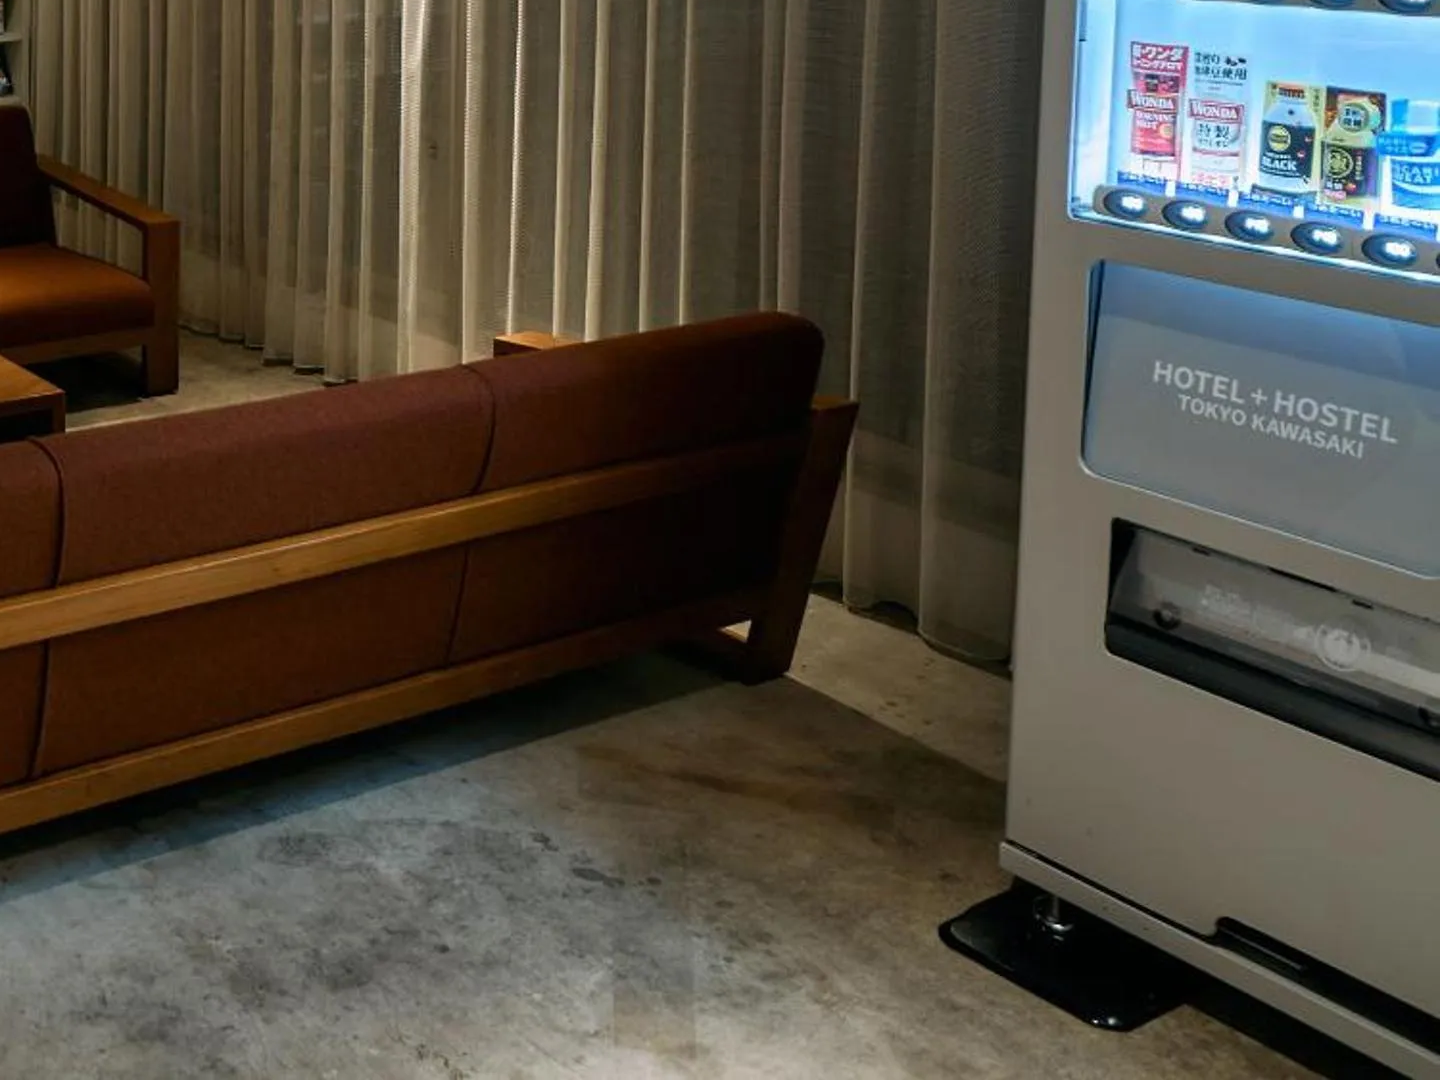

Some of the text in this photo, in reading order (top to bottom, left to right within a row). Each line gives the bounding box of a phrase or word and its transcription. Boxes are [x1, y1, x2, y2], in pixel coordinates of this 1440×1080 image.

[1191, 101, 1238, 119] WONDA
[1152, 360, 1245, 405] HOTEL
[1273, 390, 1399, 445] HOSTEL
[1178, 393, 1364, 459] TOKYO KAWASAKI
